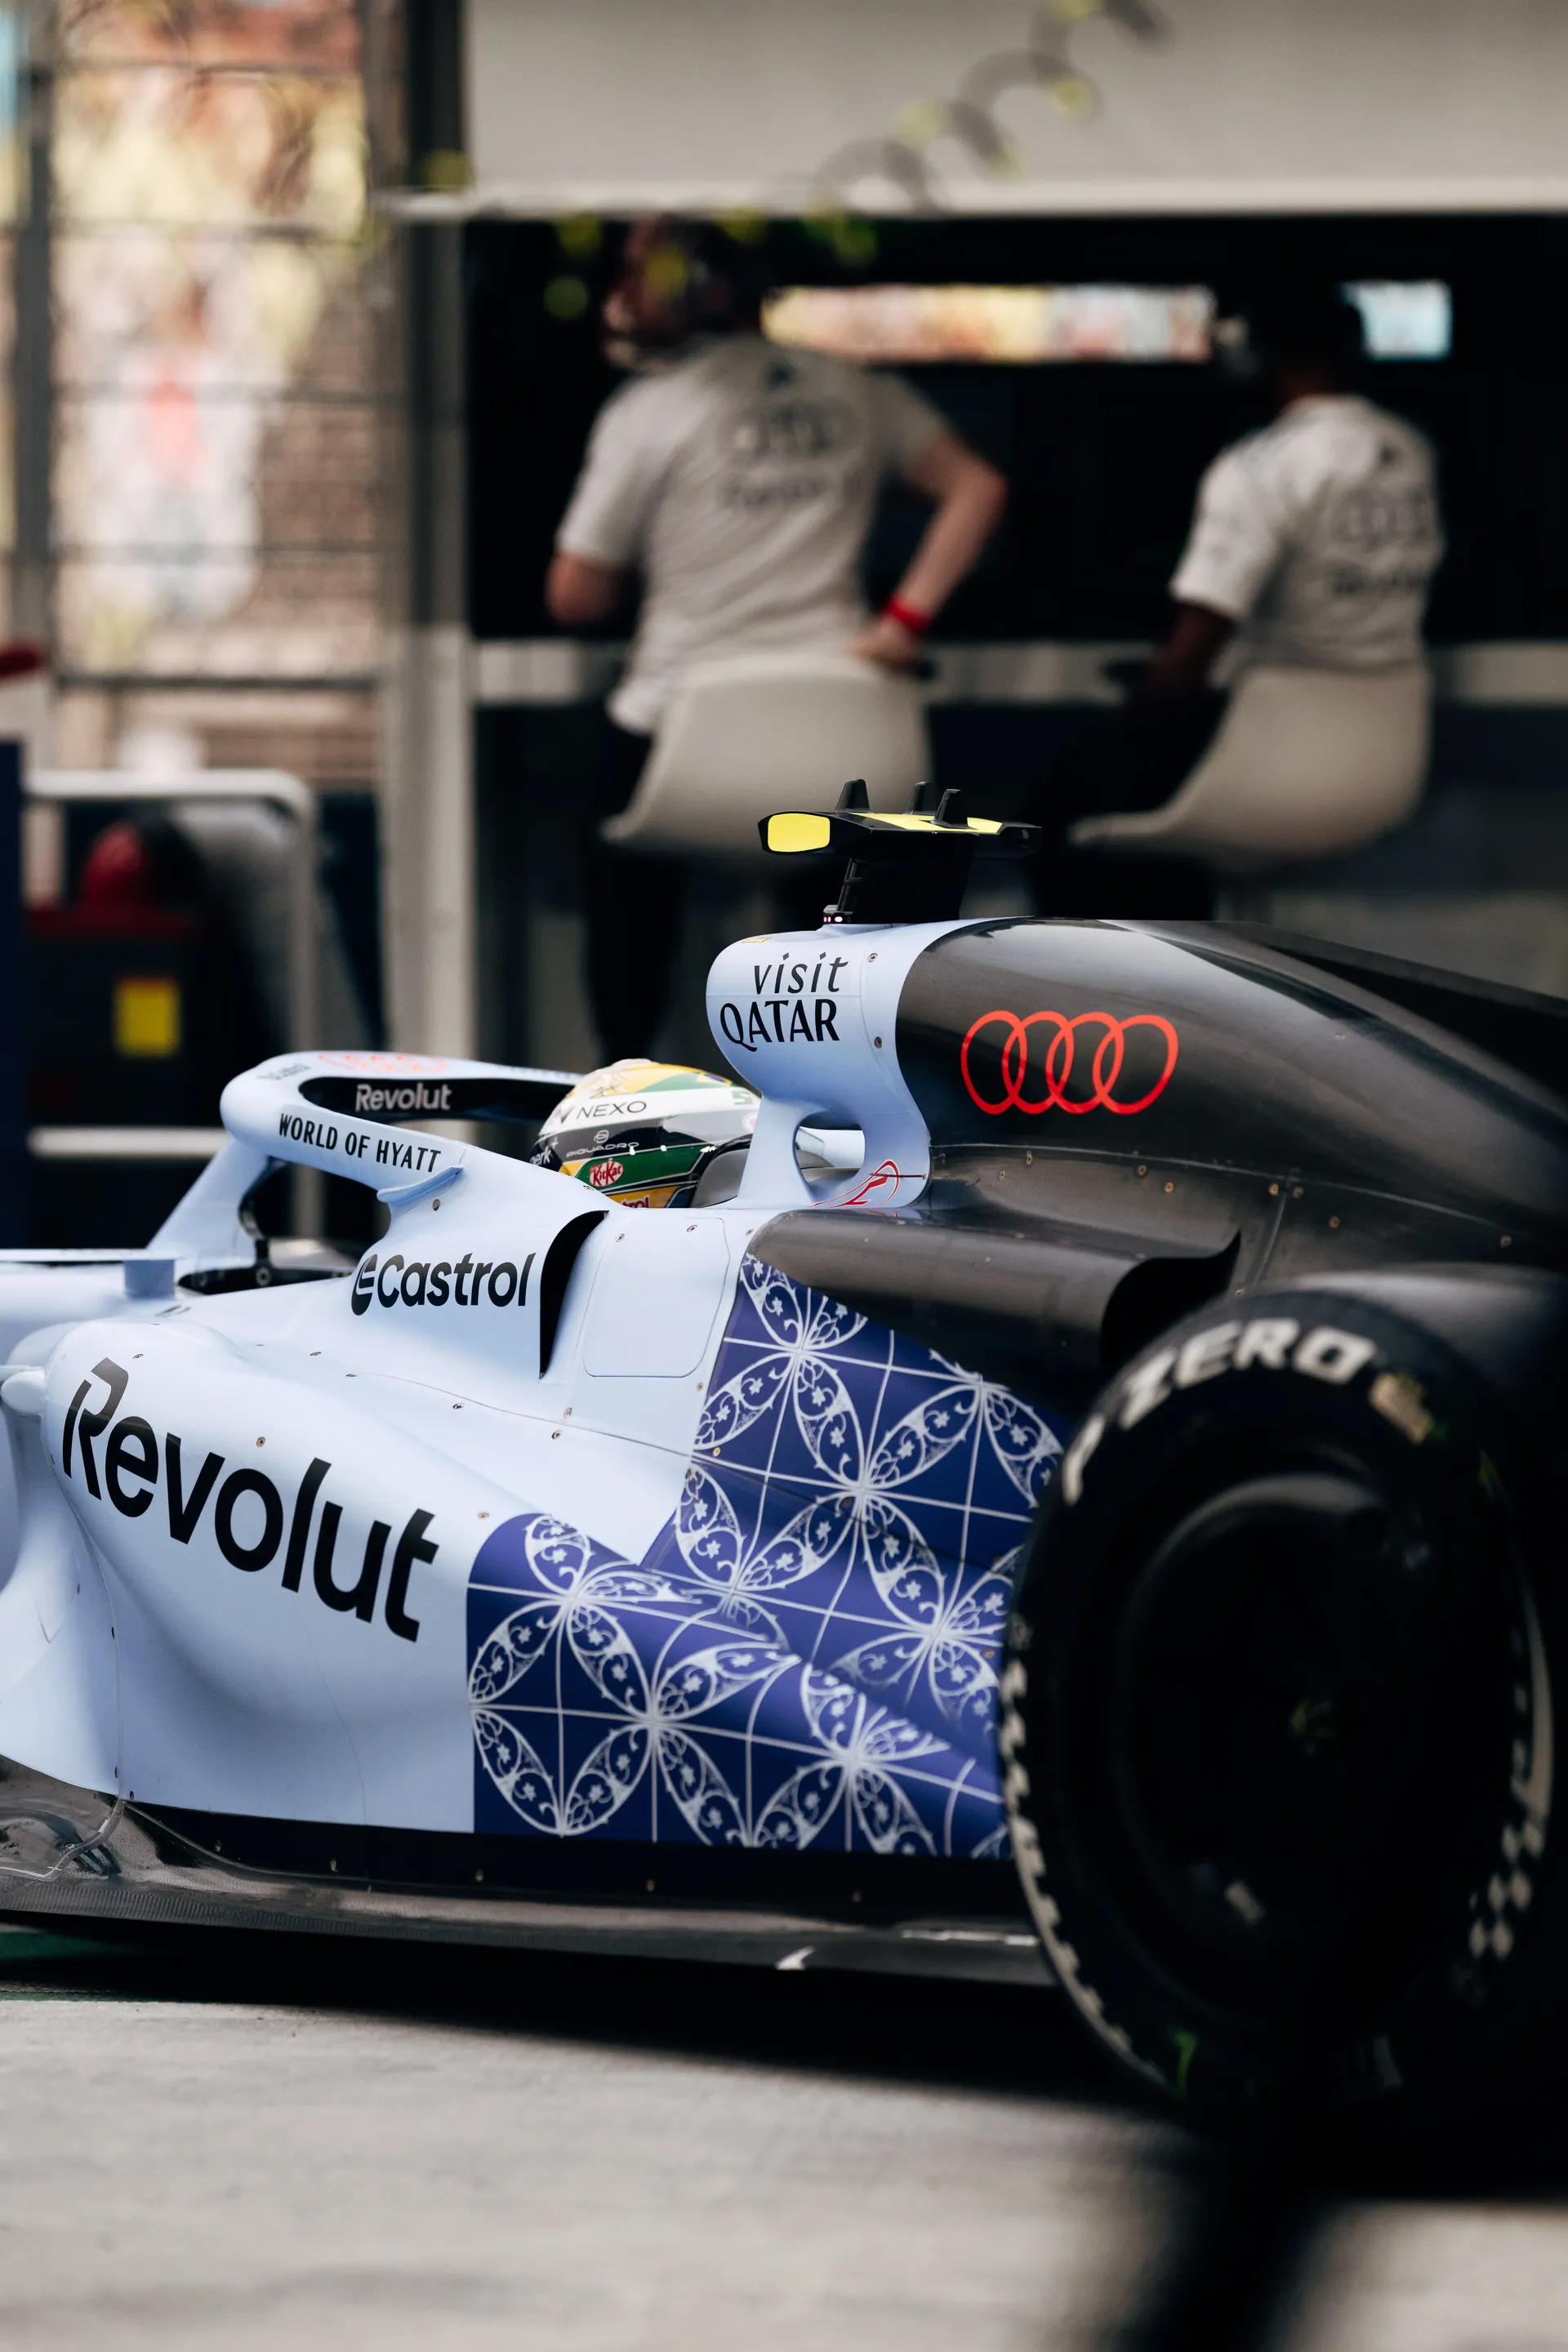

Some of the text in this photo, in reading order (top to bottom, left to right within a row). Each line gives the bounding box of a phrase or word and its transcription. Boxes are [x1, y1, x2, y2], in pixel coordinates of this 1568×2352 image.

[754, 951, 849, 995] visit
[719, 998, 840, 1052] QATAR
[355, 1081, 452, 1112] Revolut
[577, 1100, 647, 1120] NEXO
[278, 1112, 442, 1173] WORLD OF HYATT
[566, 1142, 639, 1159] PIQUADRO
[593, 1160, 622, 1187] KitKat
[376, 1252, 537, 1307] Castrol
[62, 1356, 440, 1643] Revolut
